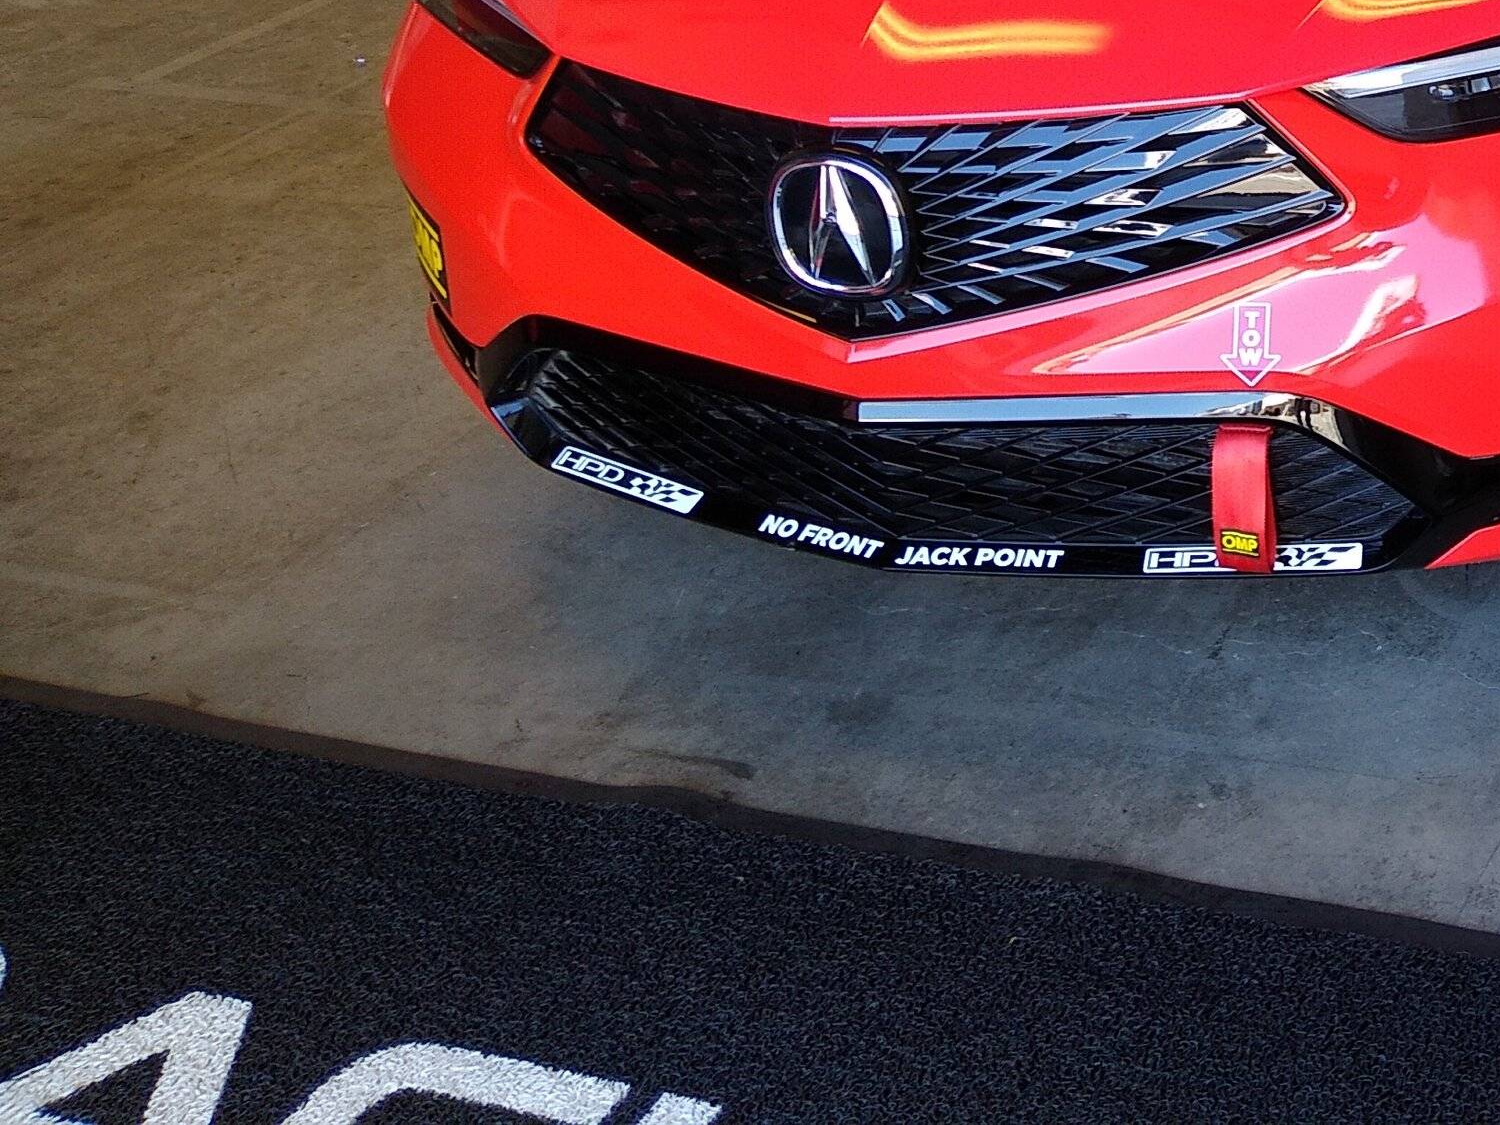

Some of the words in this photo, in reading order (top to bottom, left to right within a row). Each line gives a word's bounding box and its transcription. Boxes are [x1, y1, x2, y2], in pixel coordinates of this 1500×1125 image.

[1239, 310, 1263, 367] TOW
[560, 449, 625, 484] HPD
[759, 514, 798, 539] NO
[797, 522, 884, 559] FRONT
[1222, 534, 1258, 552] OMP
[894, 546, 977, 567] JACK
[974, 548, 1064, 569] POINT
[1149, 551, 1220, 569] HP
